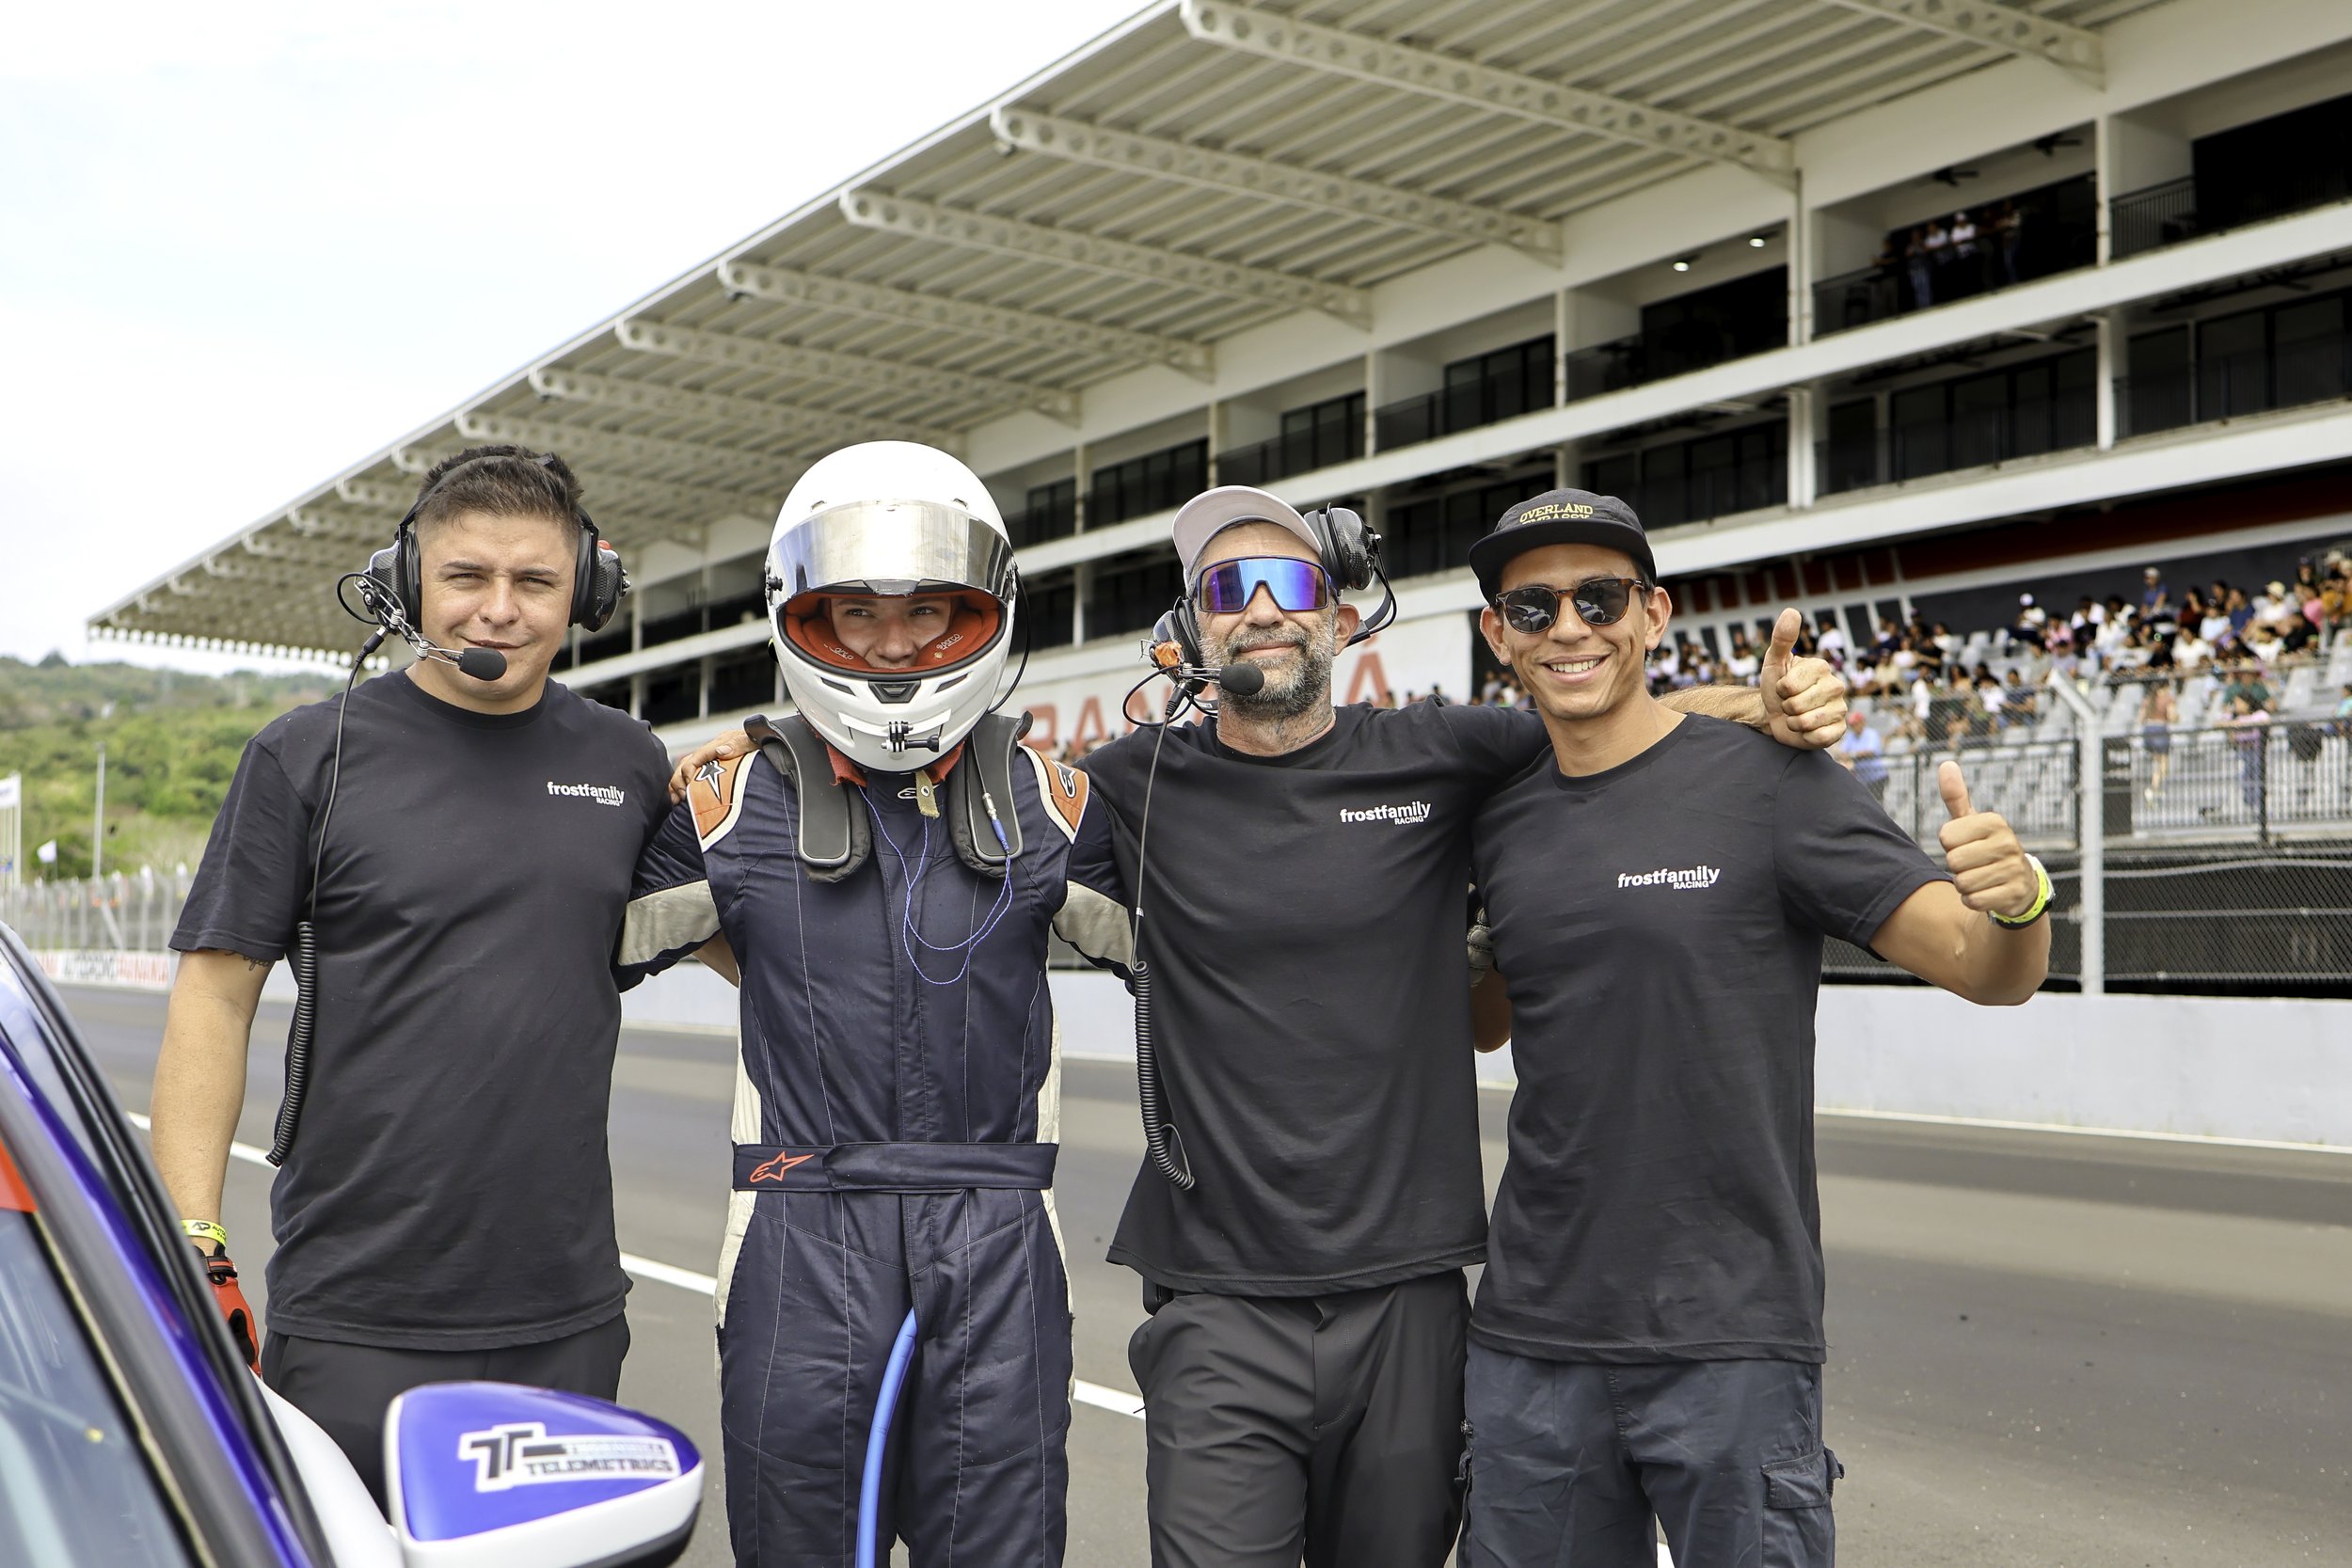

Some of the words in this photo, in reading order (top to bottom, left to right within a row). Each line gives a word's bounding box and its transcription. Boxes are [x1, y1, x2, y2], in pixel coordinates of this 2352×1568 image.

[1519, 502, 1594, 523] OVERLAND
[547, 781, 625, 804] frostfamily
[596, 798, 620, 806] RACING
[1340, 800, 1431, 822] frostfamily
[1394, 816, 1424, 825] RACING
[1617, 865, 1721, 888] frostfamily
[1673, 880, 1709, 890] RACING
[525, 1458, 674, 1476] TELEMETRICS
